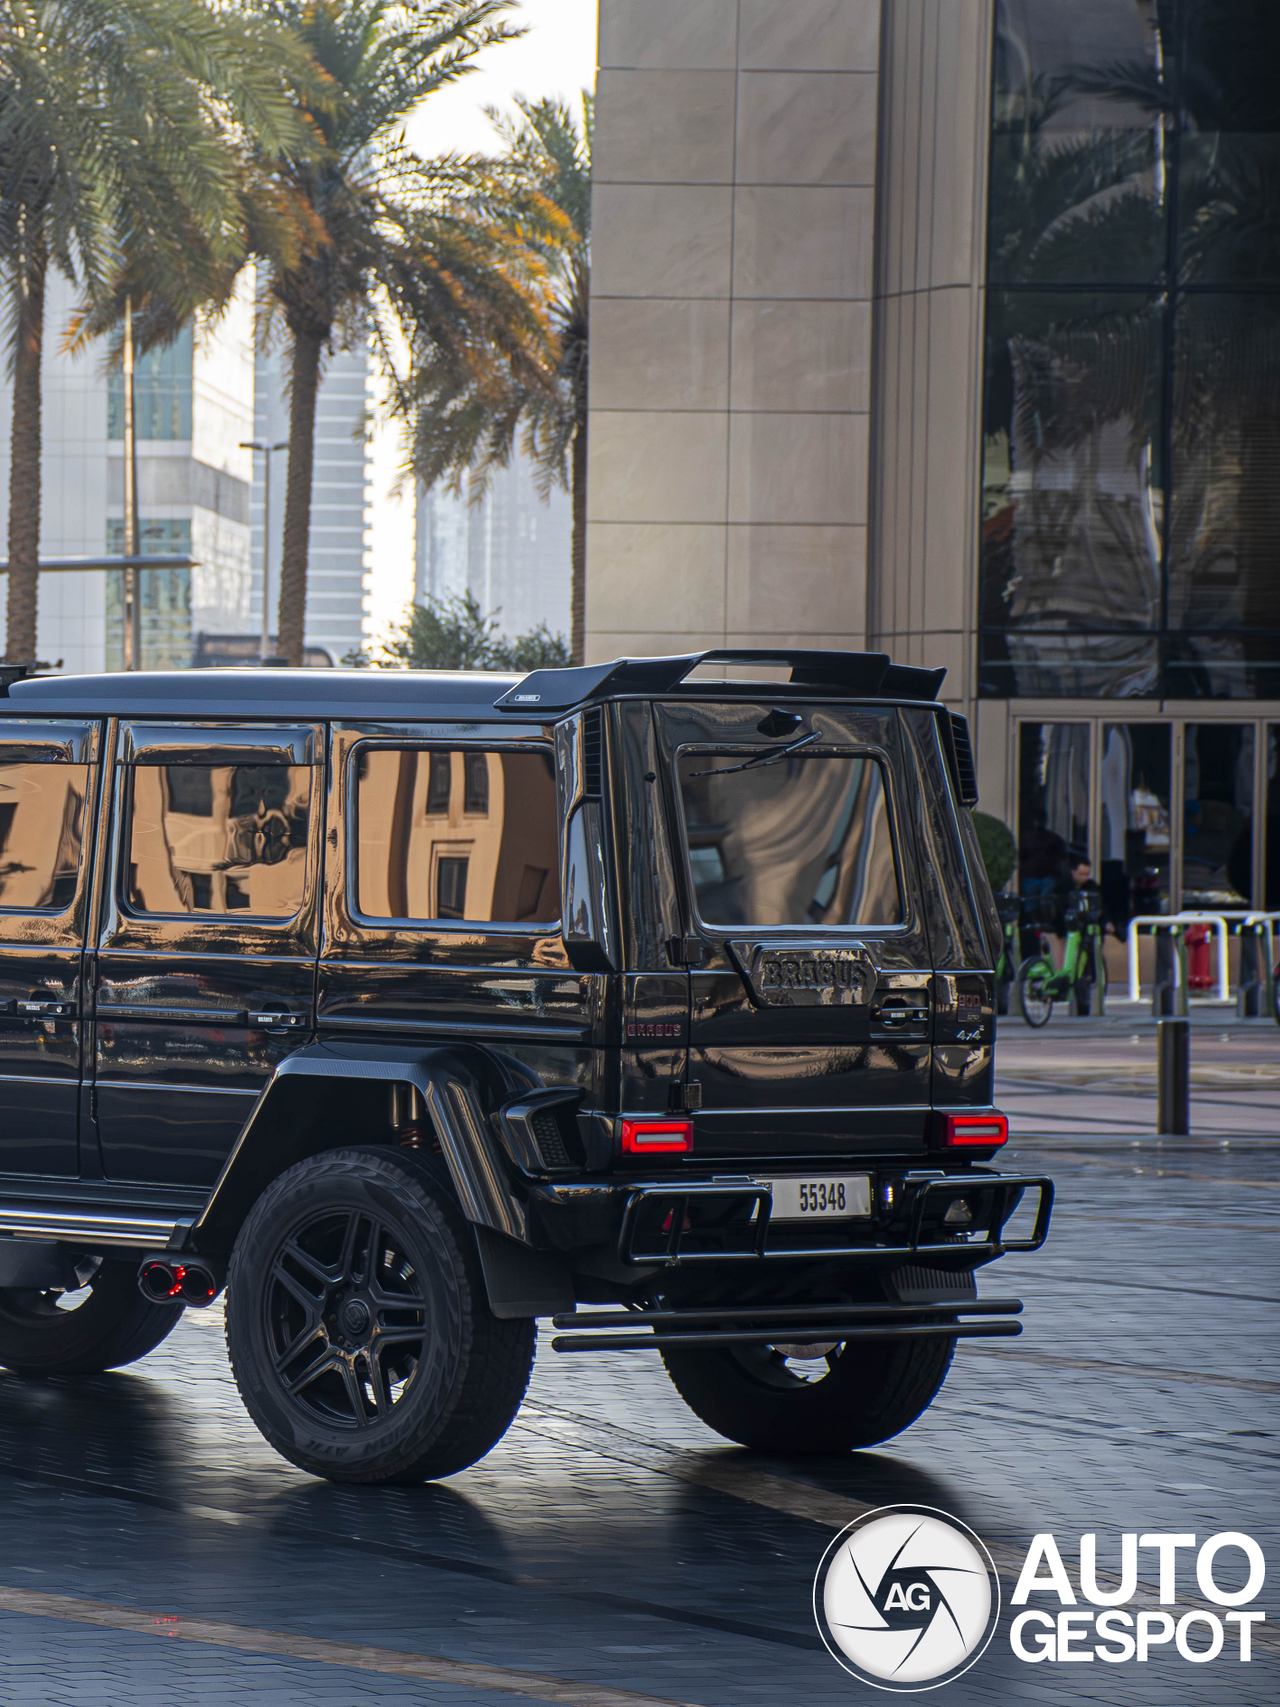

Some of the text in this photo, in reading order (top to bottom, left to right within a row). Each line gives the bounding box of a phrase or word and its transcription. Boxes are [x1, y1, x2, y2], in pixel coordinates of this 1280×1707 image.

[762, 960, 867, 989] BRABUS
[627, 1024, 682, 1037] BRABUS
[799, 1182, 846, 1212] 55348
